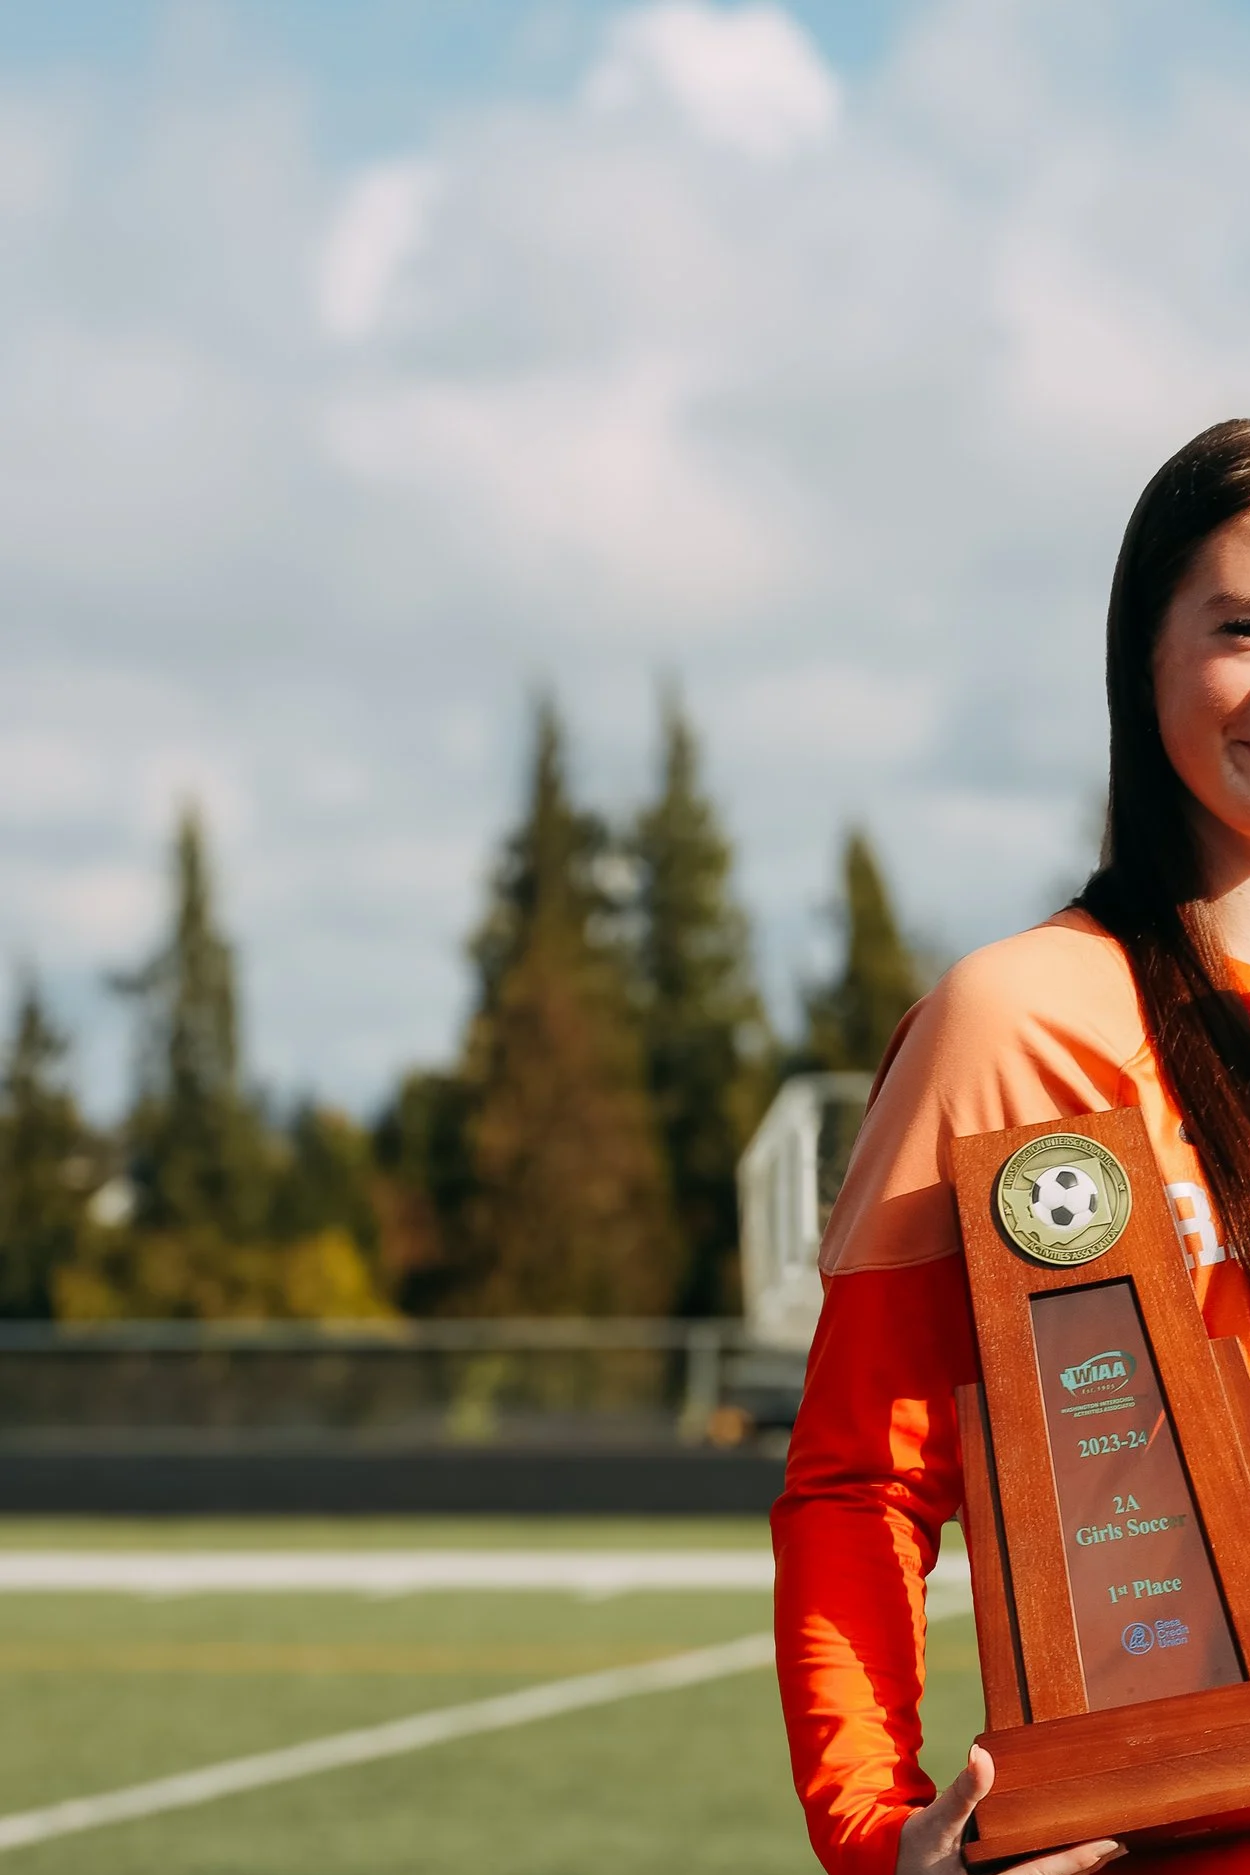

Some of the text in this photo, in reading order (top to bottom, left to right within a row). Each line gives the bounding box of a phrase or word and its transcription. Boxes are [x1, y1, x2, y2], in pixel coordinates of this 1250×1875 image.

[1004, 1137, 1116, 1190] WASHINGTON INTERSCHOLASTIC
[1027, 1228, 1120, 1260] ACTIVITIES ASSOCIATION
[1072, 1360, 1127, 1385] WIAA
[1077, 1430, 1148, 1458] 2023-24
[1112, 1494, 1141, 1515] 2A
[1075, 1513, 1187, 1547] Girls Soccer
[1108, 1577, 1183, 1604] 1st Place
[1156, 1625, 1190, 1640] Credit
[1158, 1636, 1189, 1649] Union
